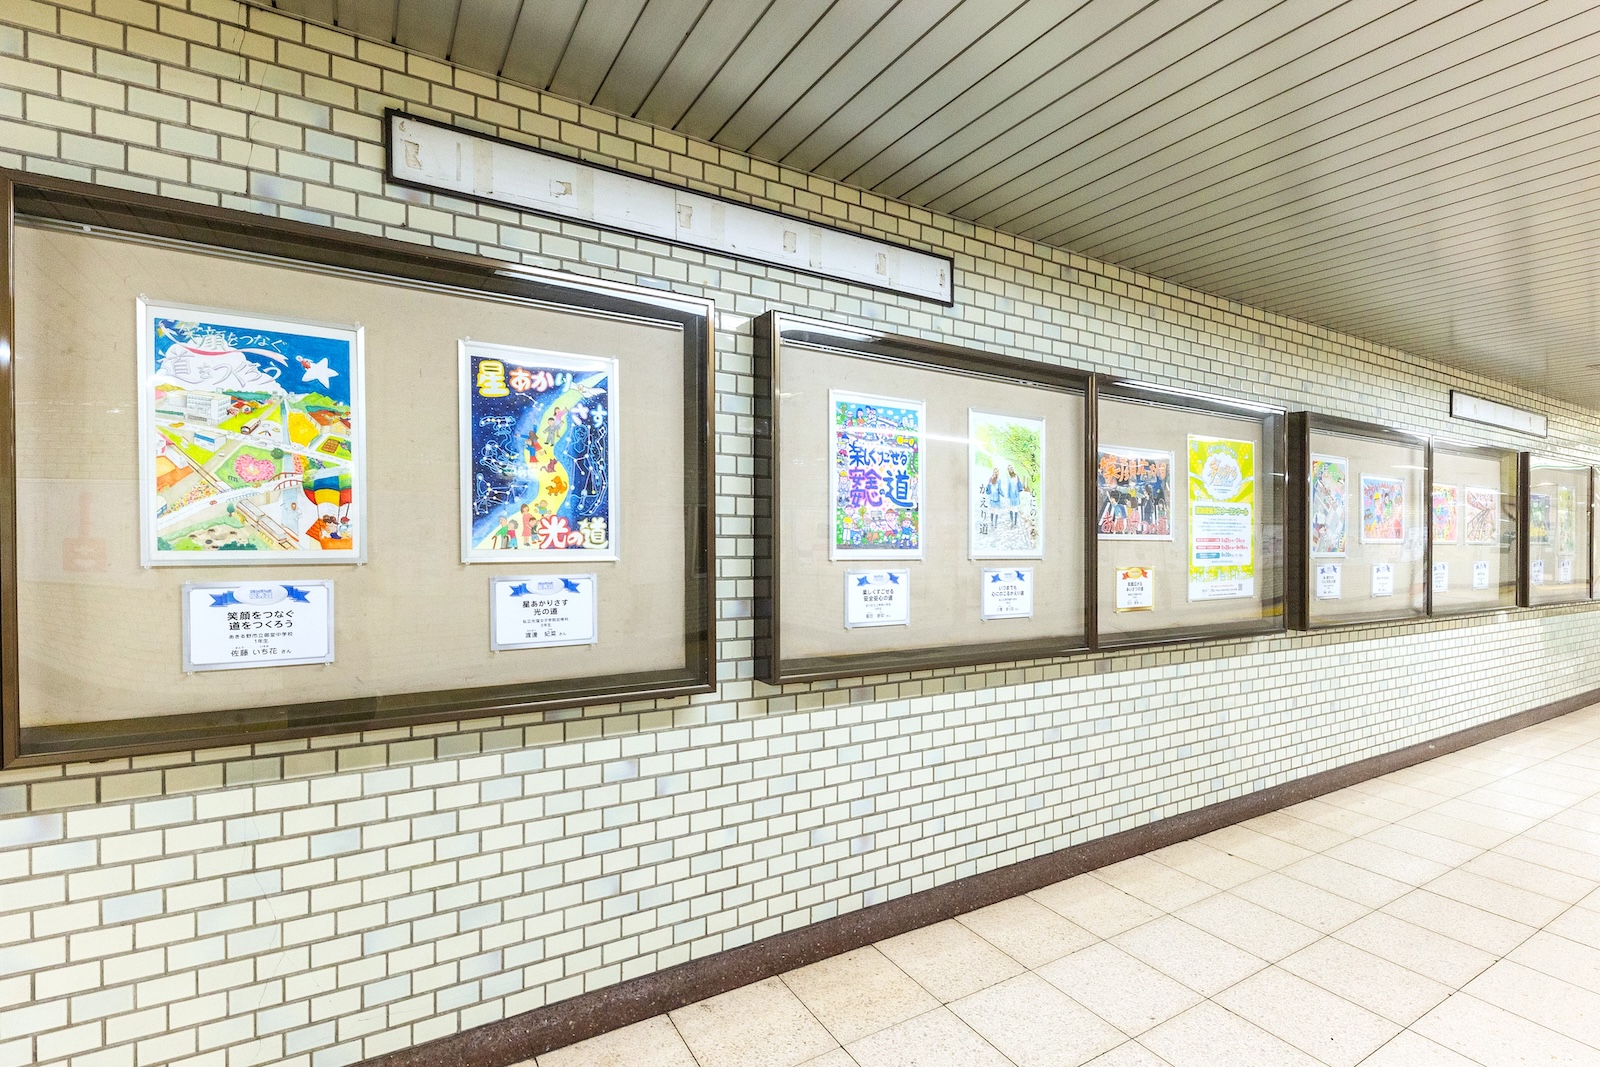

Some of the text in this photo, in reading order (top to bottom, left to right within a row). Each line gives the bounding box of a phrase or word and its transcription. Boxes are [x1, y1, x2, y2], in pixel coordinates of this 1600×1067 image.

[157, 349, 283, 388] 道をつくろう
[477, 359, 574, 397] 星あかり
[570, 402, 607, 428] さす
[538, 515, 609, 549] 光の道
[522, 599, 569, 609] 星あかりさす
[227, 609, 295, 621] 笑顔をつなぐ
[533, 607, 558, 616] 光の道
[229, 619, 294, 631] 道をつくろう
[230, 649, 249, 657] 佐藤
[252, 647, 278, 656] いち花
